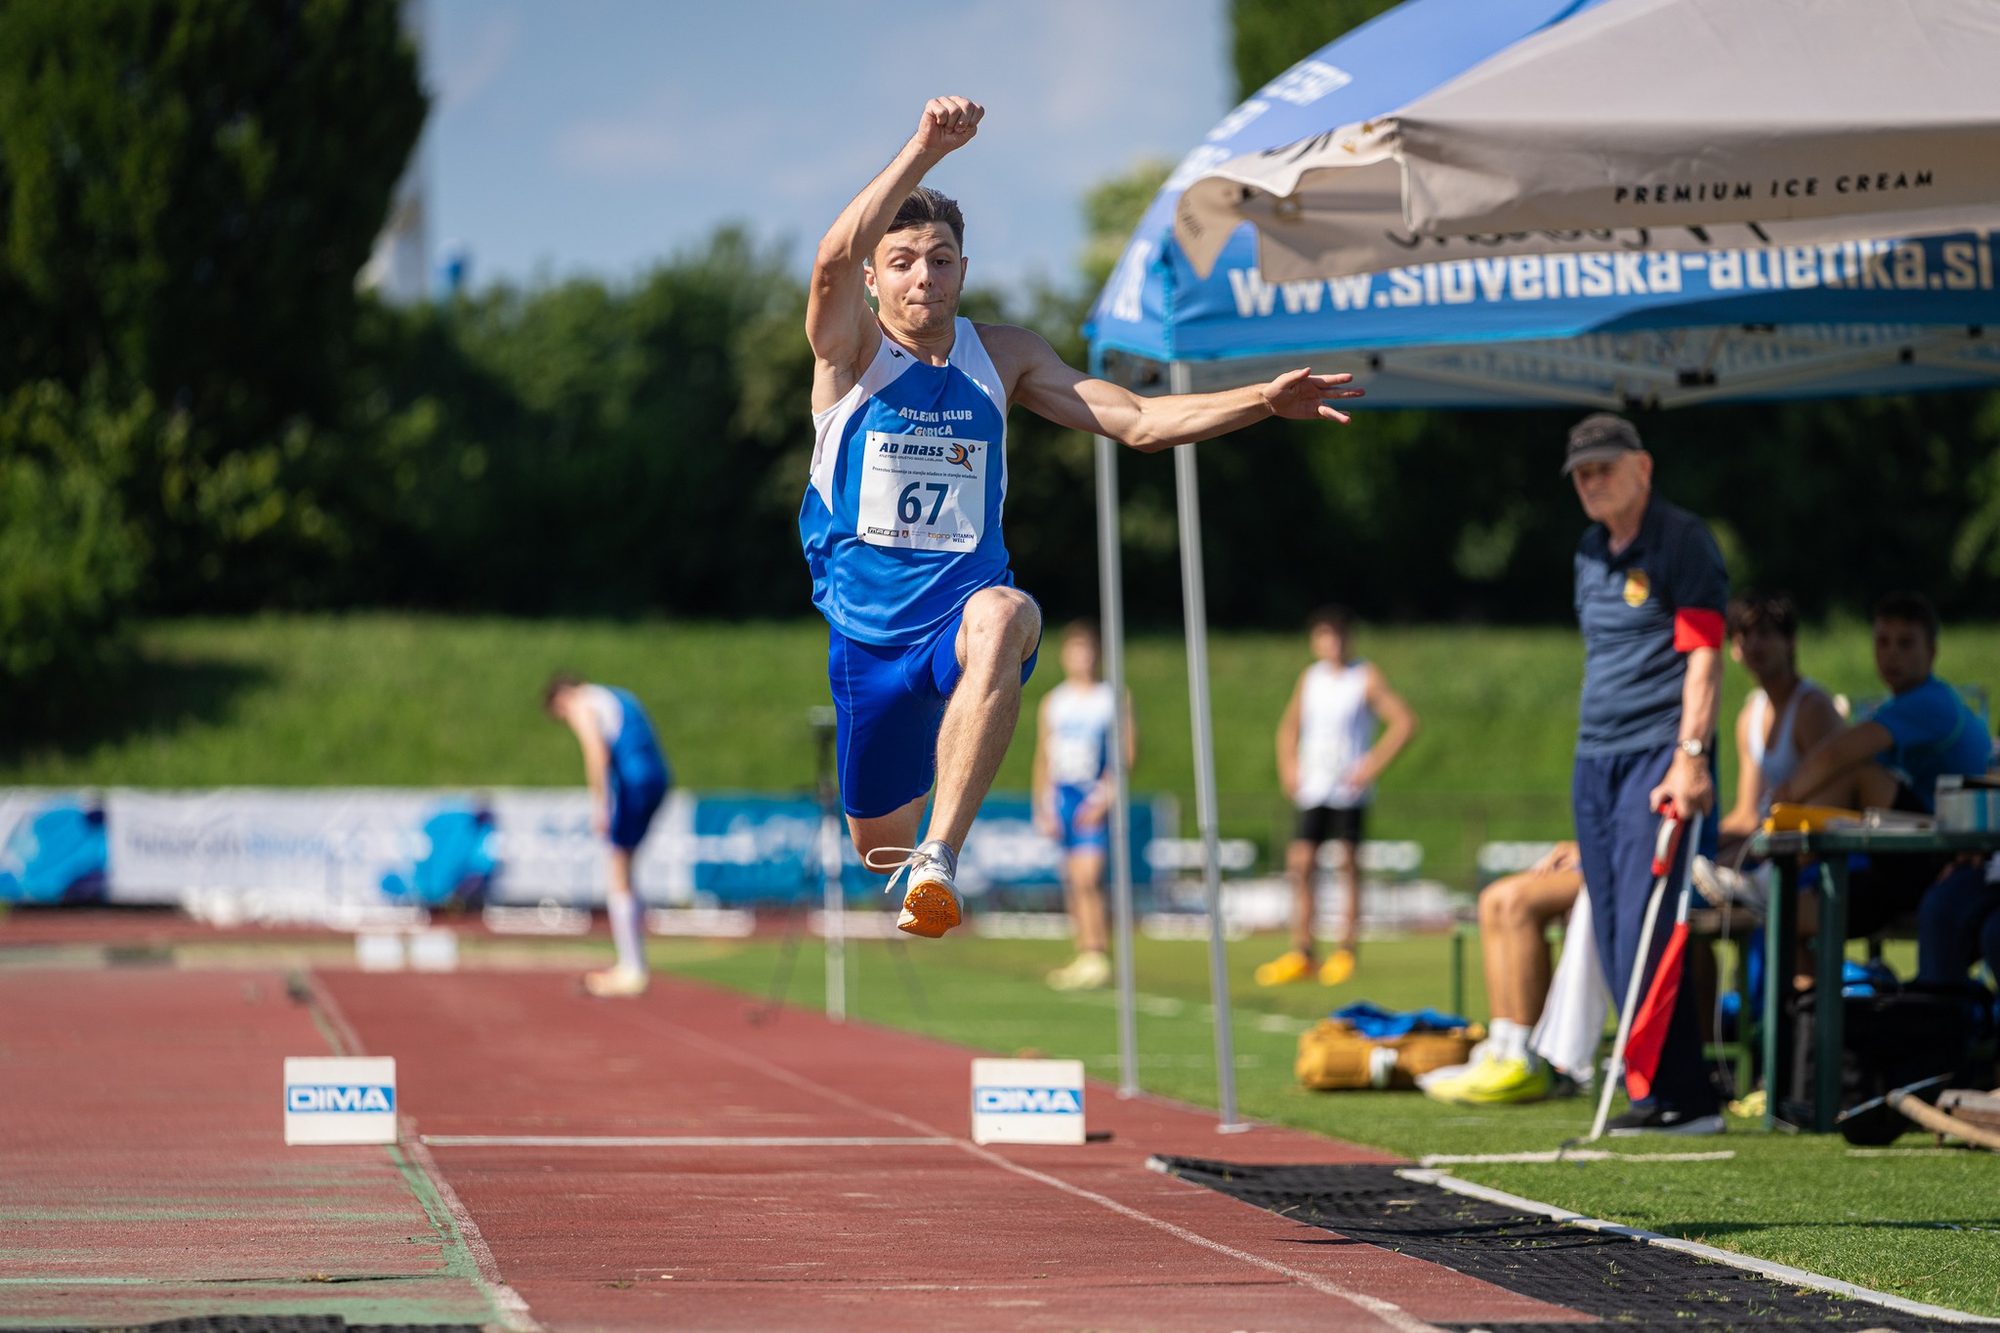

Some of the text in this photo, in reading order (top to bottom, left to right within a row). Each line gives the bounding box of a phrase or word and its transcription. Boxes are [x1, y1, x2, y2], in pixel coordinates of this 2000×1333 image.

[1615, 170, 1934, 203] PREMIUM ICE CREAM
[942, 410, 973, 420] KLUB
[879, 443, 899, 453] AD
[897, 482, 949, 525] 67
[290, 1087, 391, 1111] DIMA
[977, 1088, 1081, 1112] DIMA
